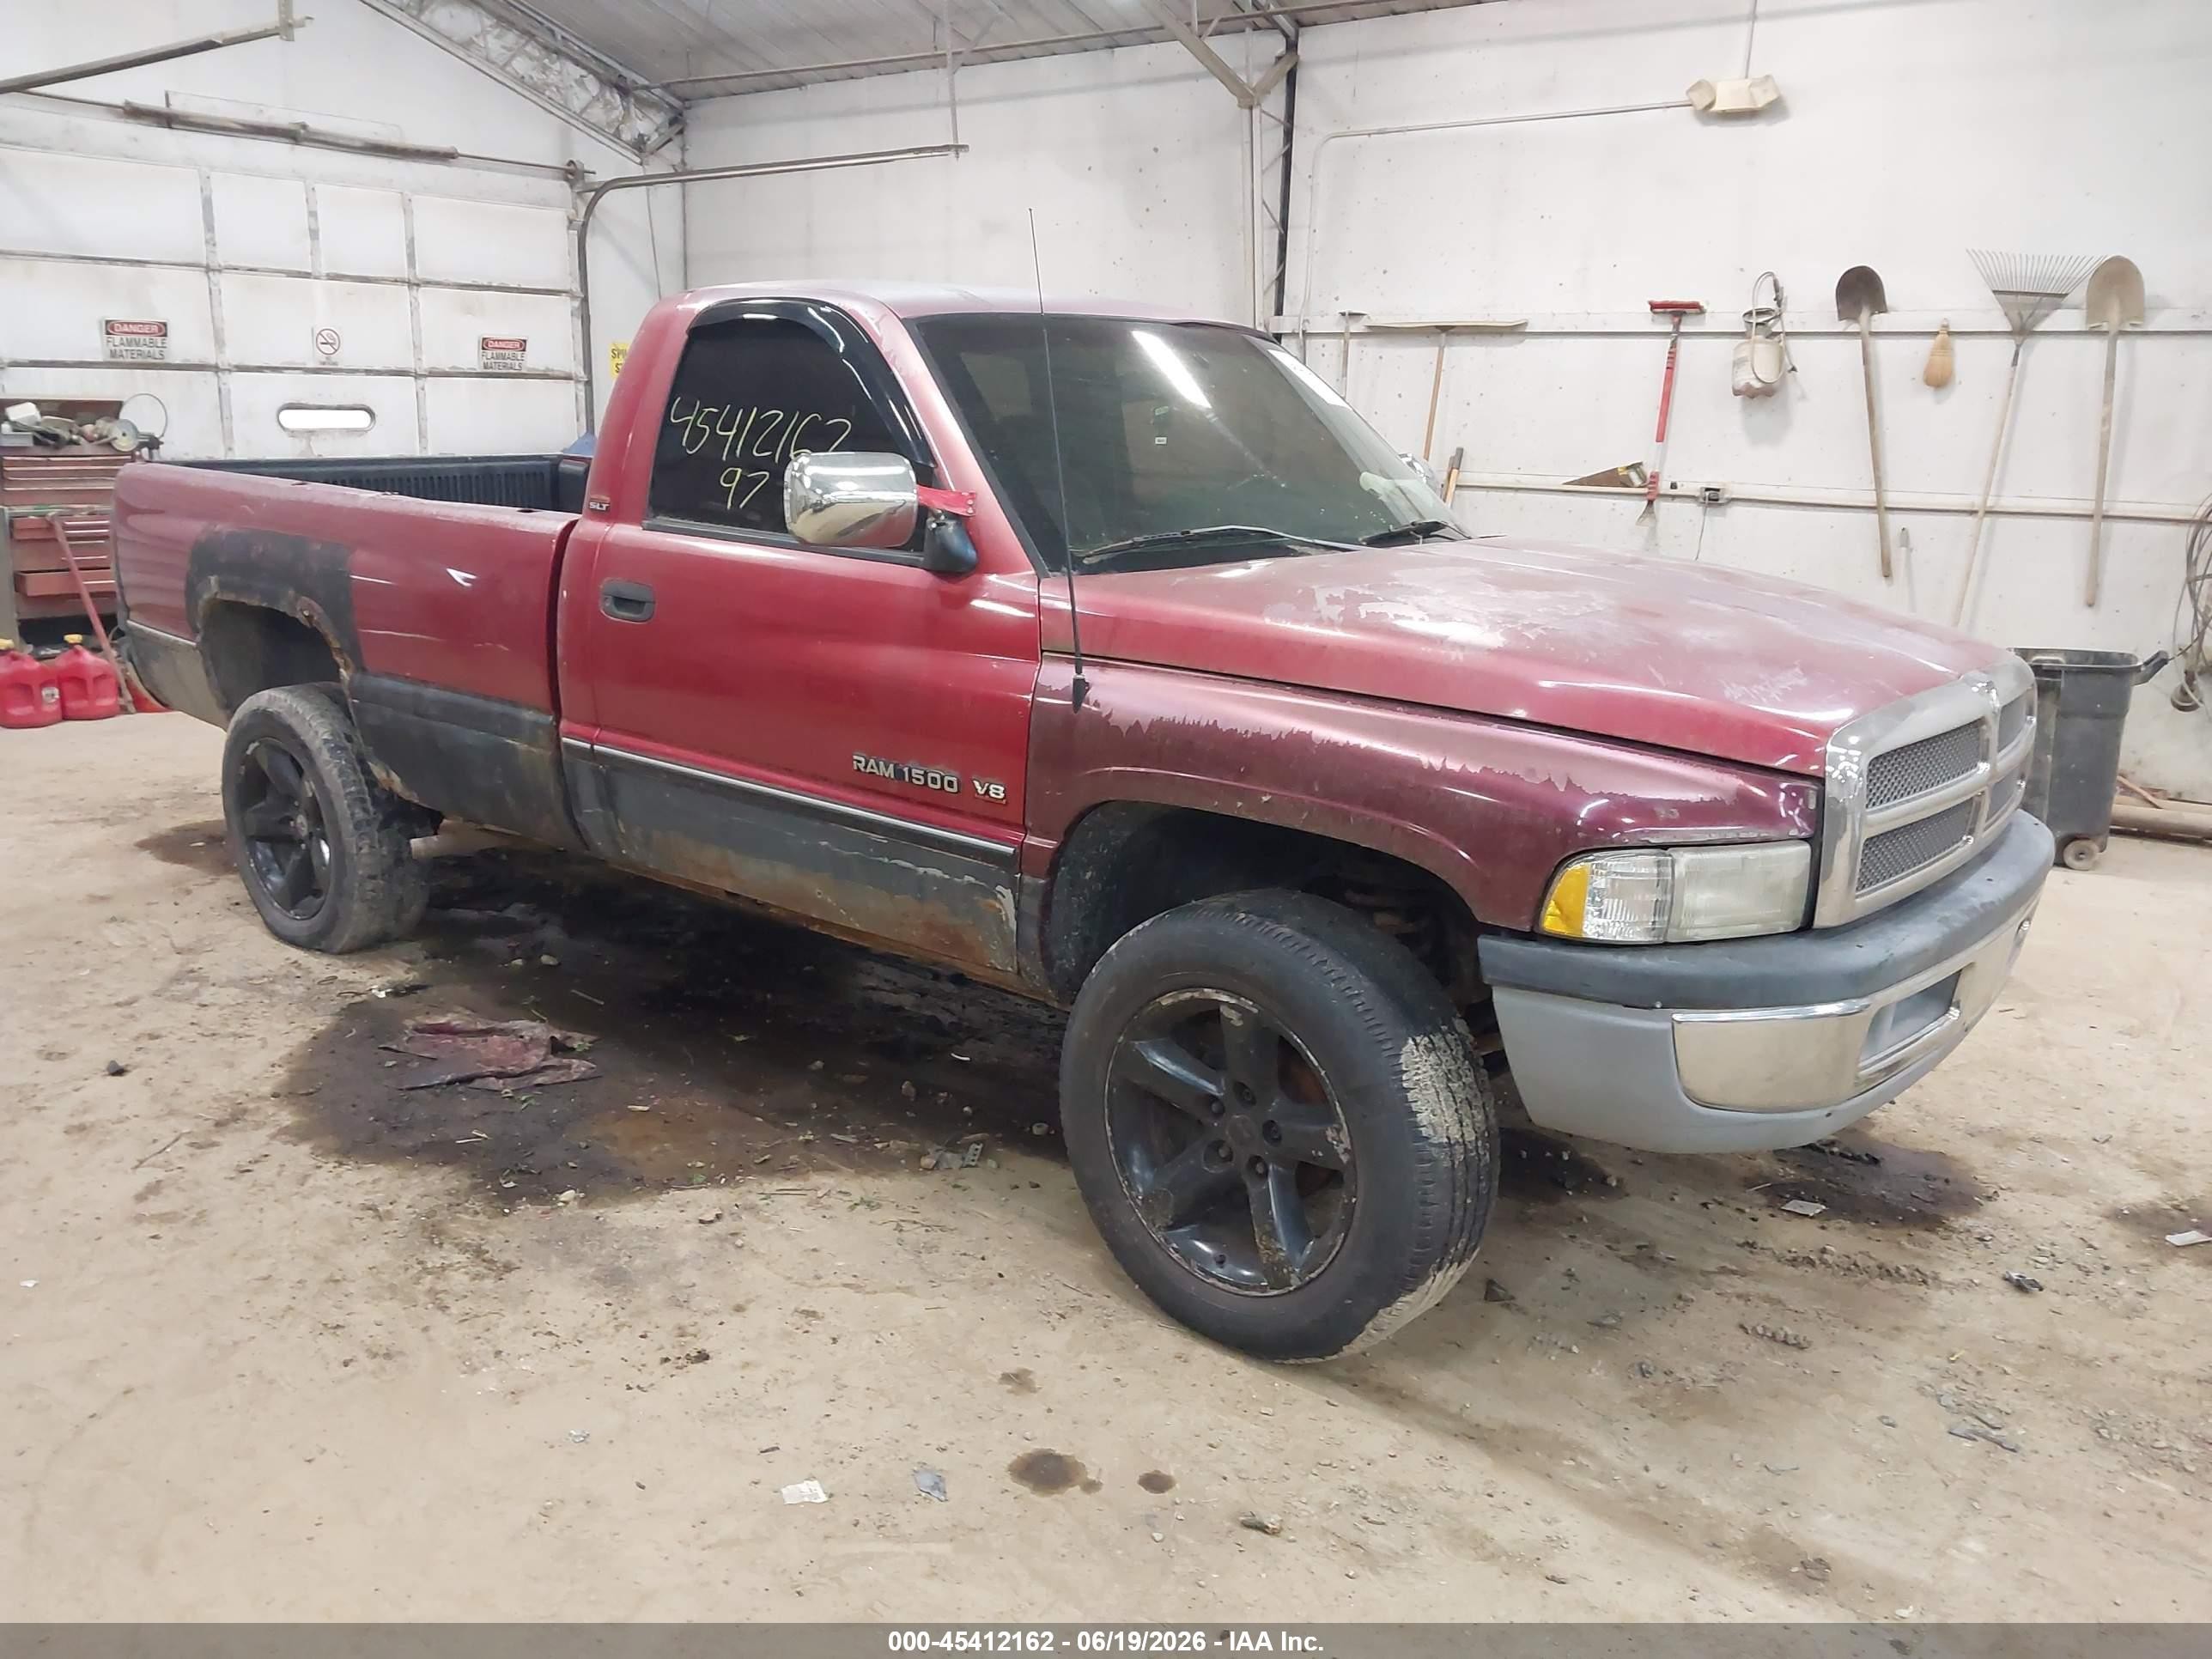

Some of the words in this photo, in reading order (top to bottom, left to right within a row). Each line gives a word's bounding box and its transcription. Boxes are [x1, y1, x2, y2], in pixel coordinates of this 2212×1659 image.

[113, 323, 159, 333] DANGER
[106, 336, 167, 349] FLAMMABLE
[487, 340, 520, 349] DANGER
[109, 349, 166, 360] MATERIALS
[481, 351, 525, 362] FLAMMABLE
[483, 362, 523, 371] MATERIALS
[720, 467, 770, 510] 97
[589, 501, 611, 511] SLT
[852, 754, 895, 780] RAM
[902, 766, 959, 793] 1500
[973, 779, 1006, 799] V8
